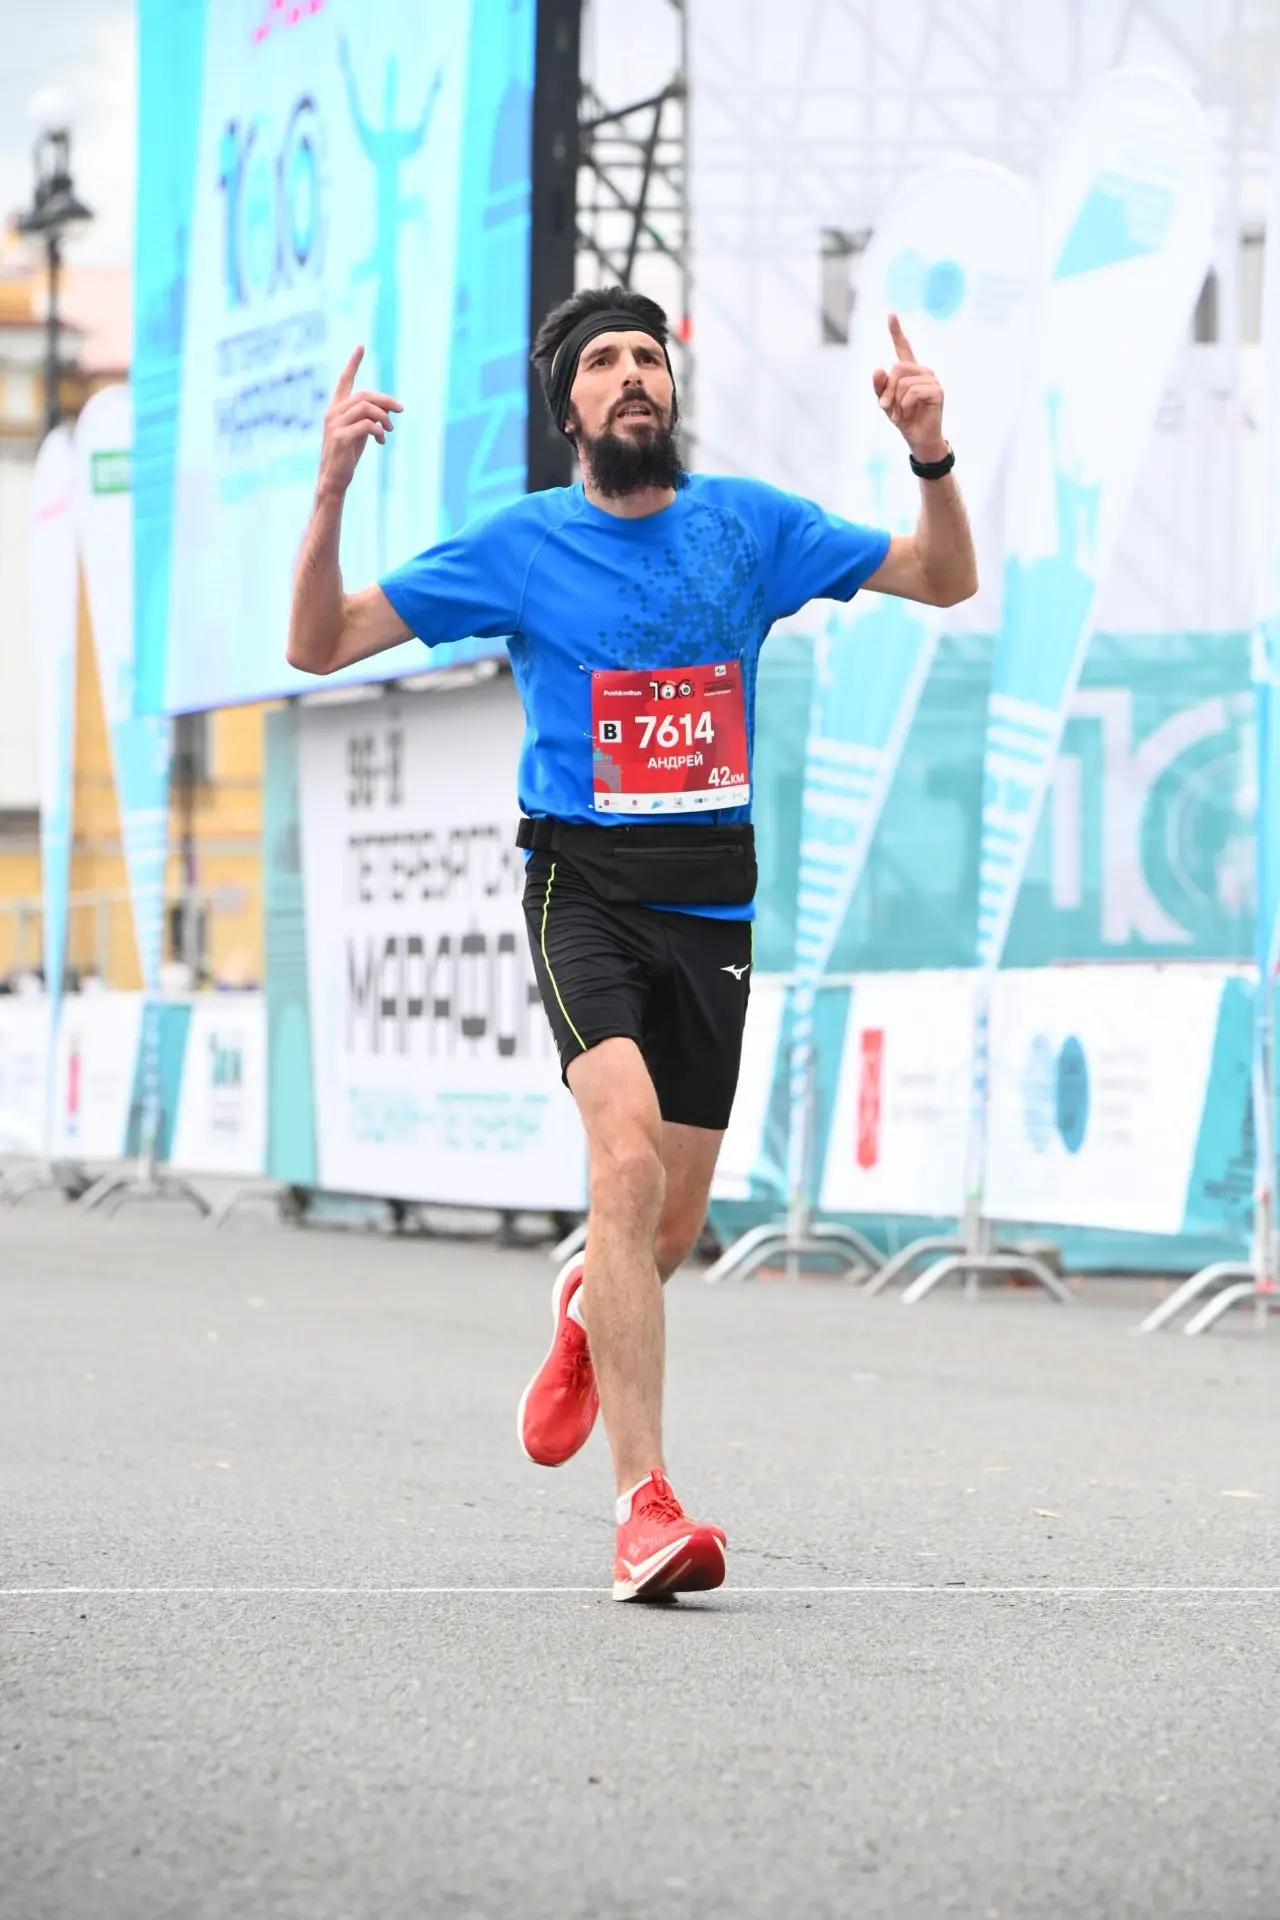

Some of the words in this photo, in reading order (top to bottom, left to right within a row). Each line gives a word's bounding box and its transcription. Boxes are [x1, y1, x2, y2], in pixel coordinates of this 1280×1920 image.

[603, 723, 617, 740] B
[634, 711, 715, 748] 7614
[647, 751, 704, 770] АНДРЕЙ
